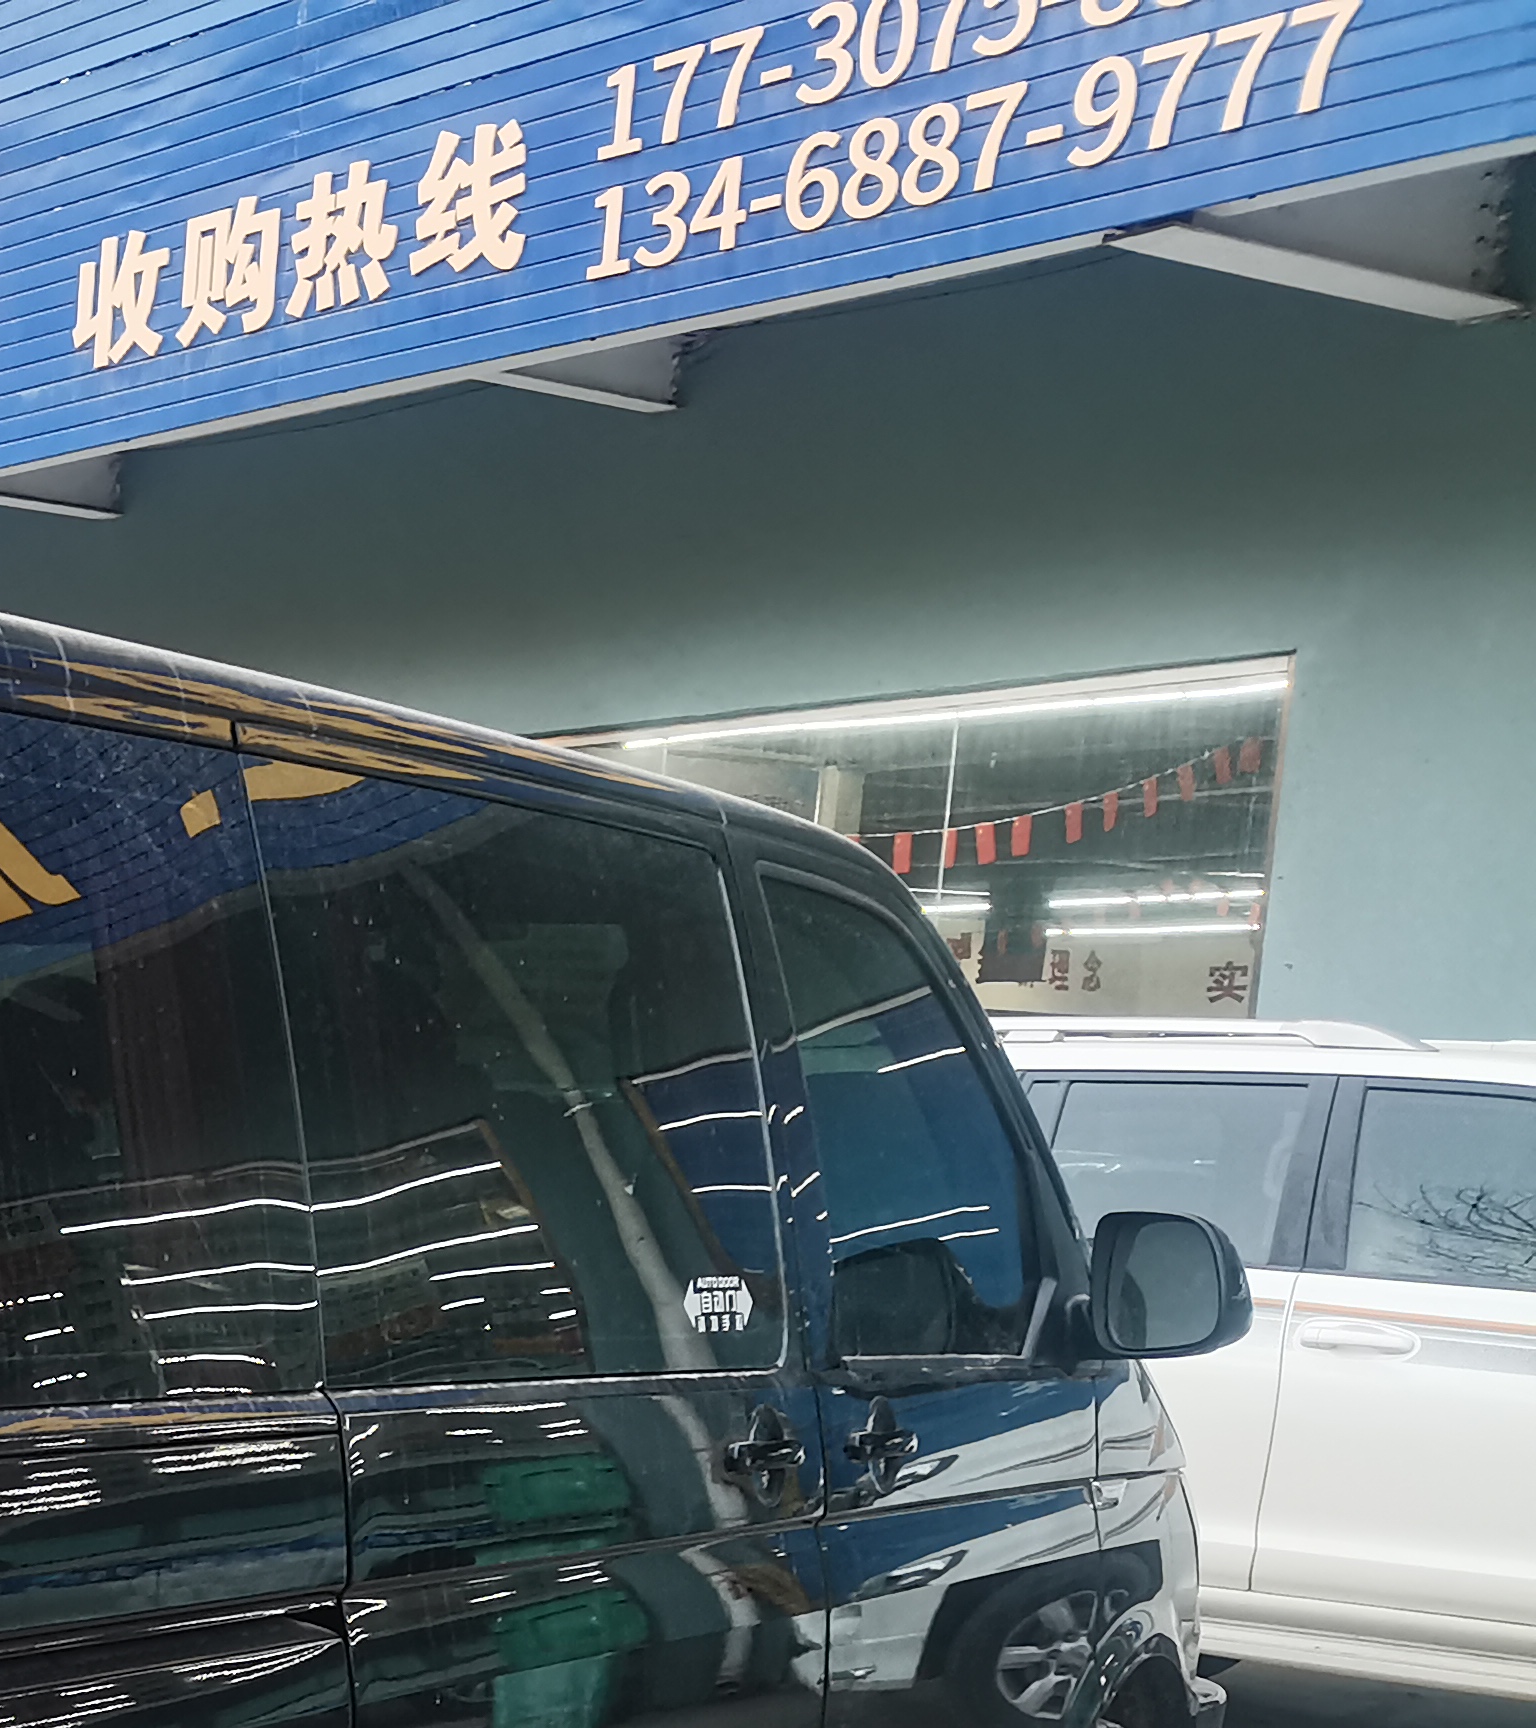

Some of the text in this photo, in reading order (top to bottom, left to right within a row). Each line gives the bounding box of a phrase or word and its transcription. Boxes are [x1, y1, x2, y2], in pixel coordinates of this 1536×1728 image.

[71, 117, 528, 367] 收购热线
[584, 0, 1366, 281] 134-6887-9777
[1206, 961, 1248, 1004] 实
